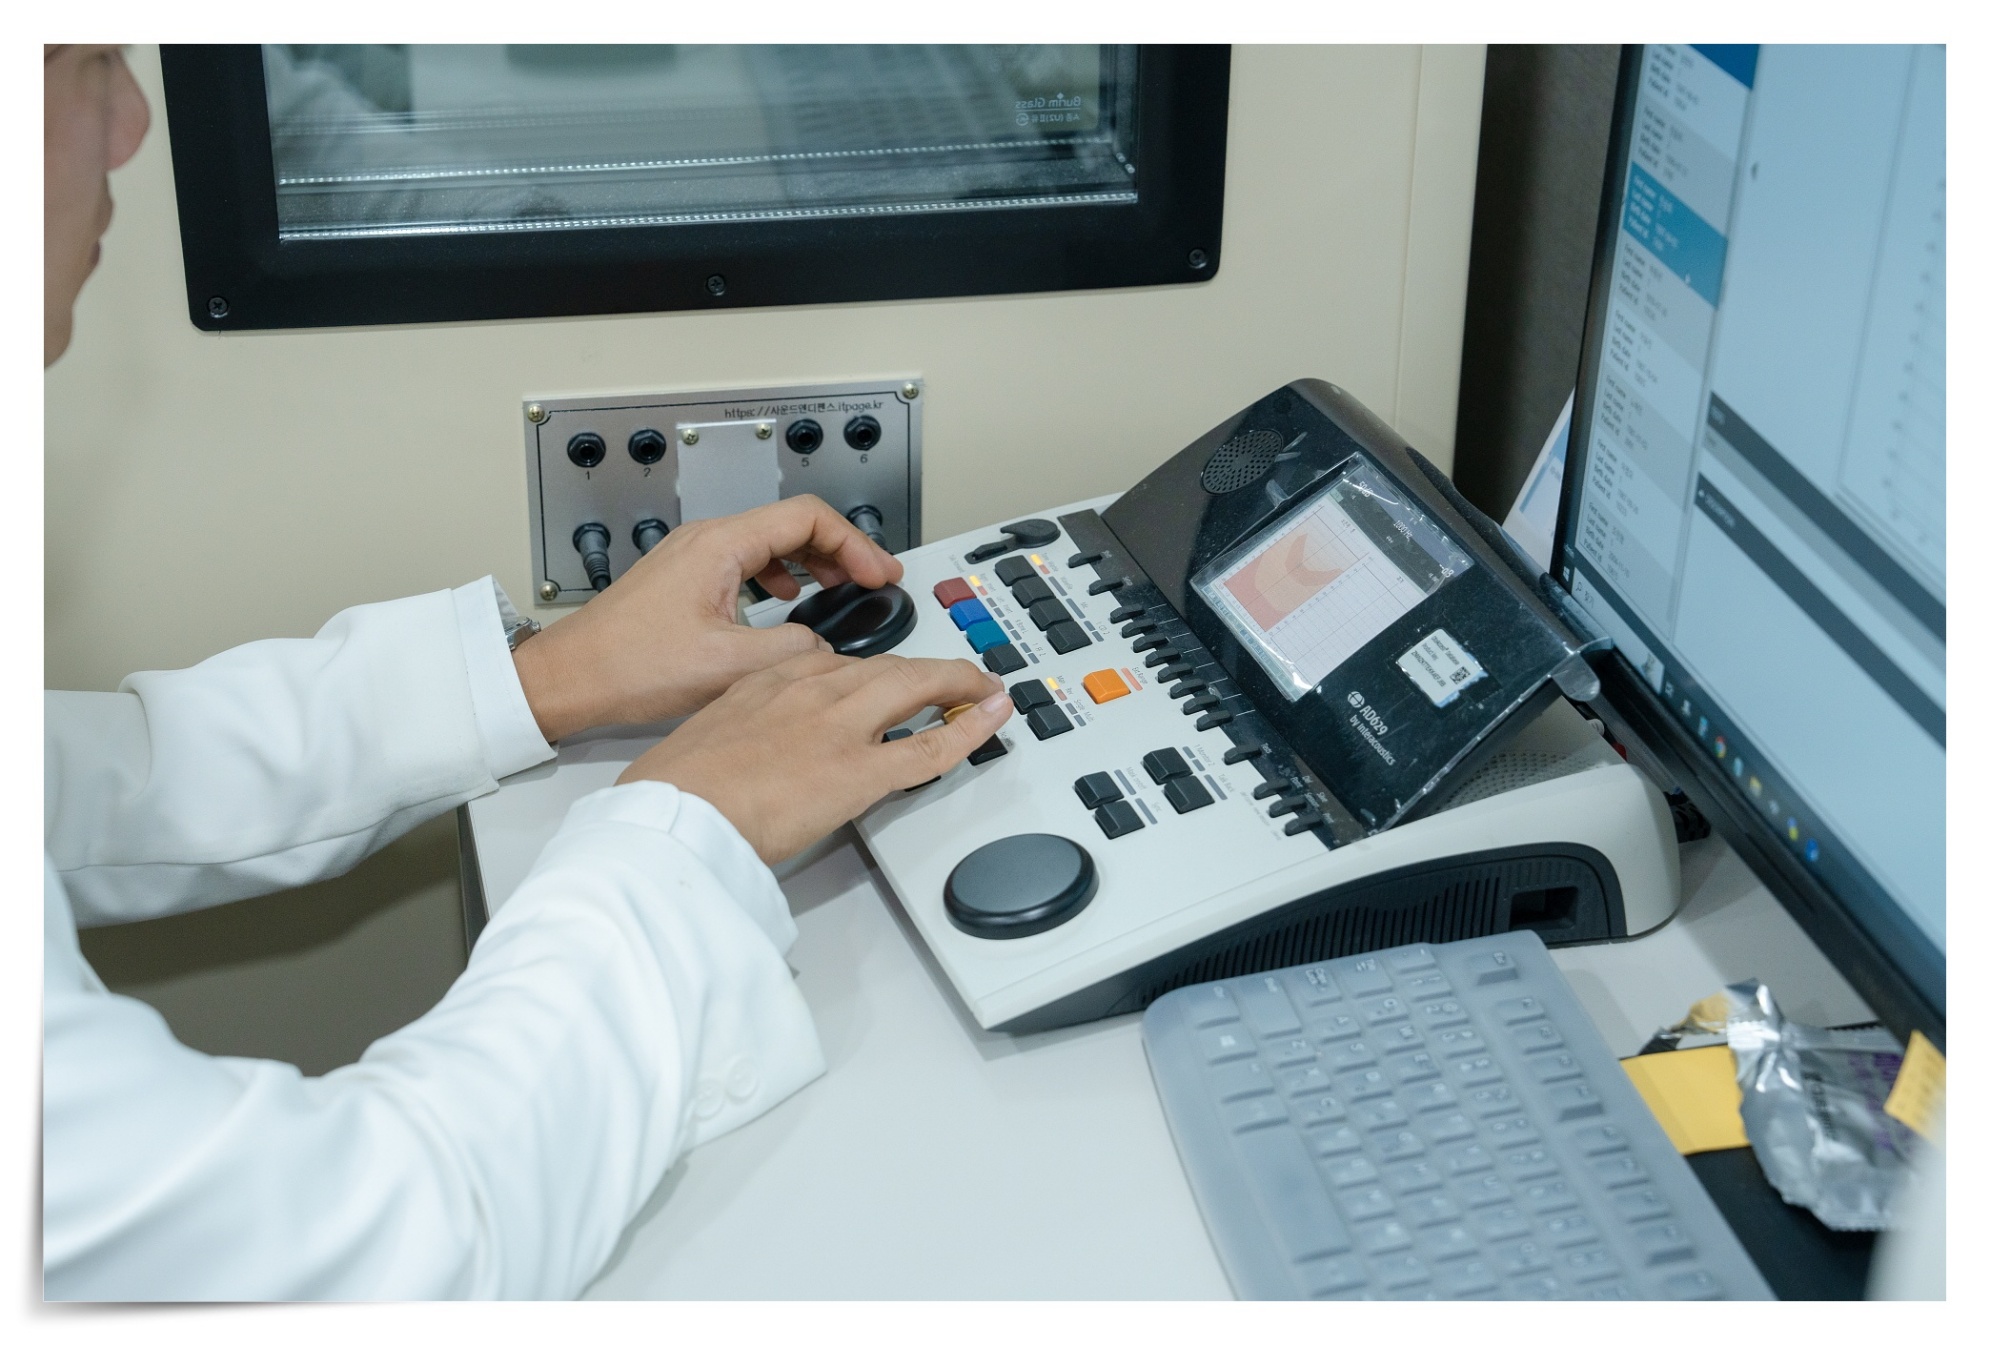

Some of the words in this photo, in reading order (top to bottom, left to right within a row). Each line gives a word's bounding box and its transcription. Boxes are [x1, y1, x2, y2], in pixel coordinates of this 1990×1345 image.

[801, 457, 810, 468] 5
[860, 454, 868, 464] 6
[585, 470, 591, 480] 1
[643, 467, 651, 478] 2
[1393, 520, 1407, 533] 1000
[1349, 714, 1360, 727] by
[1359, 704, 1388, 736] AD629
